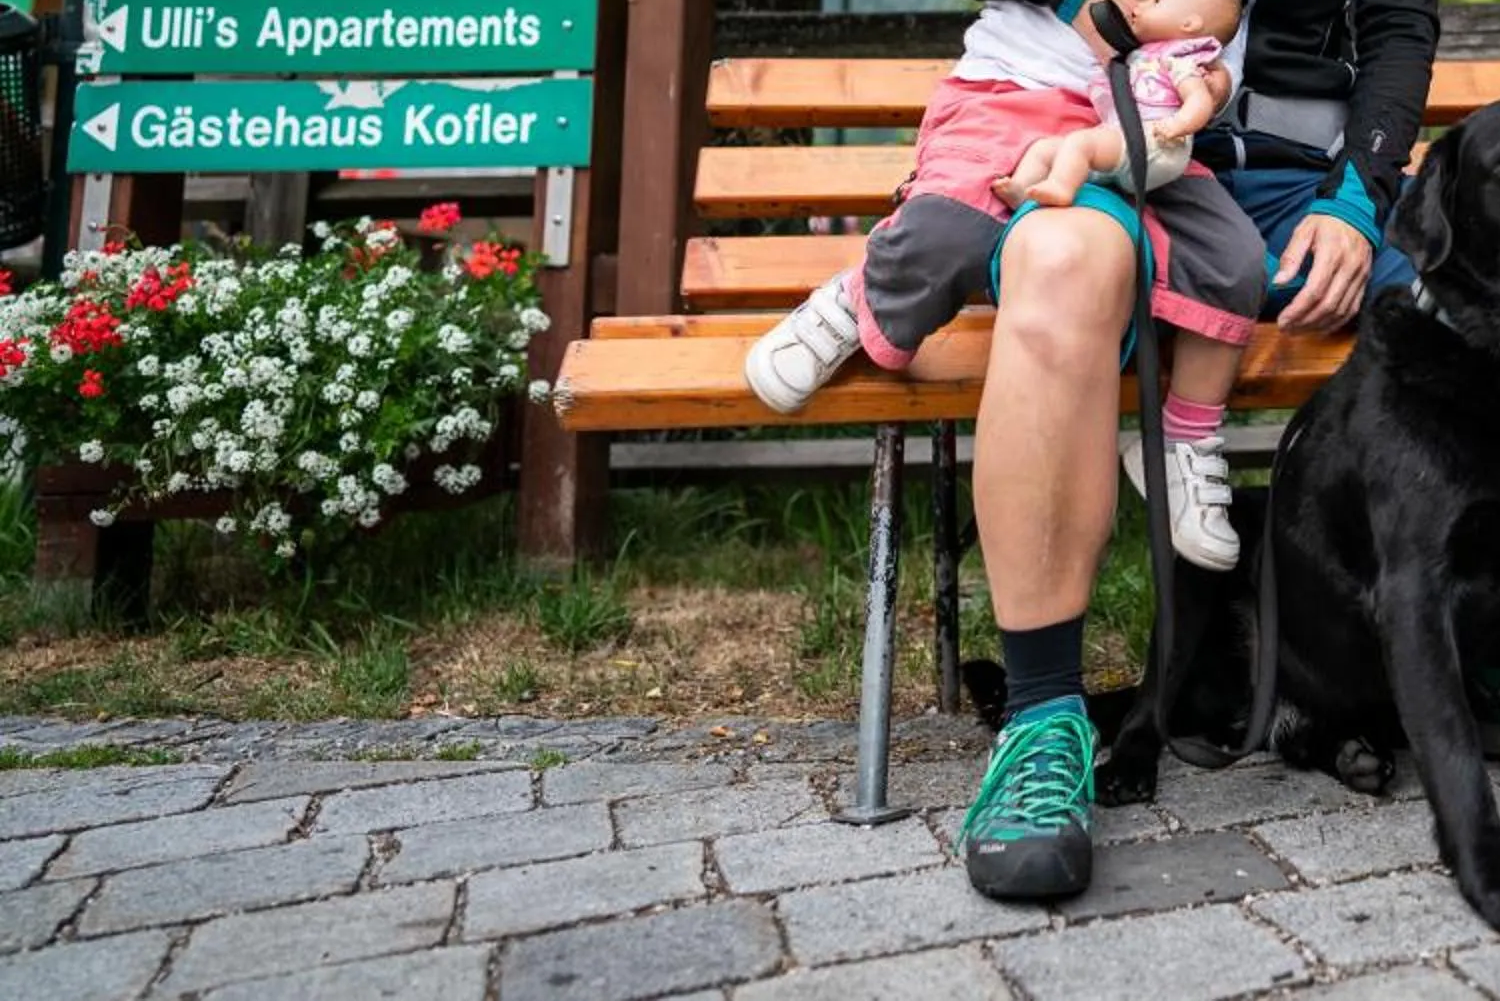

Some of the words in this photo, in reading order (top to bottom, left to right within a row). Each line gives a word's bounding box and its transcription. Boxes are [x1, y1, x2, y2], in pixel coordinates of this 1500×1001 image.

[142, 6, 239, 49] Ulli's
[257, 7, 541, 55] Appartements
[131, 104, 383, 149] Gästehaus
[403, 103, 537, 146] Kofler
